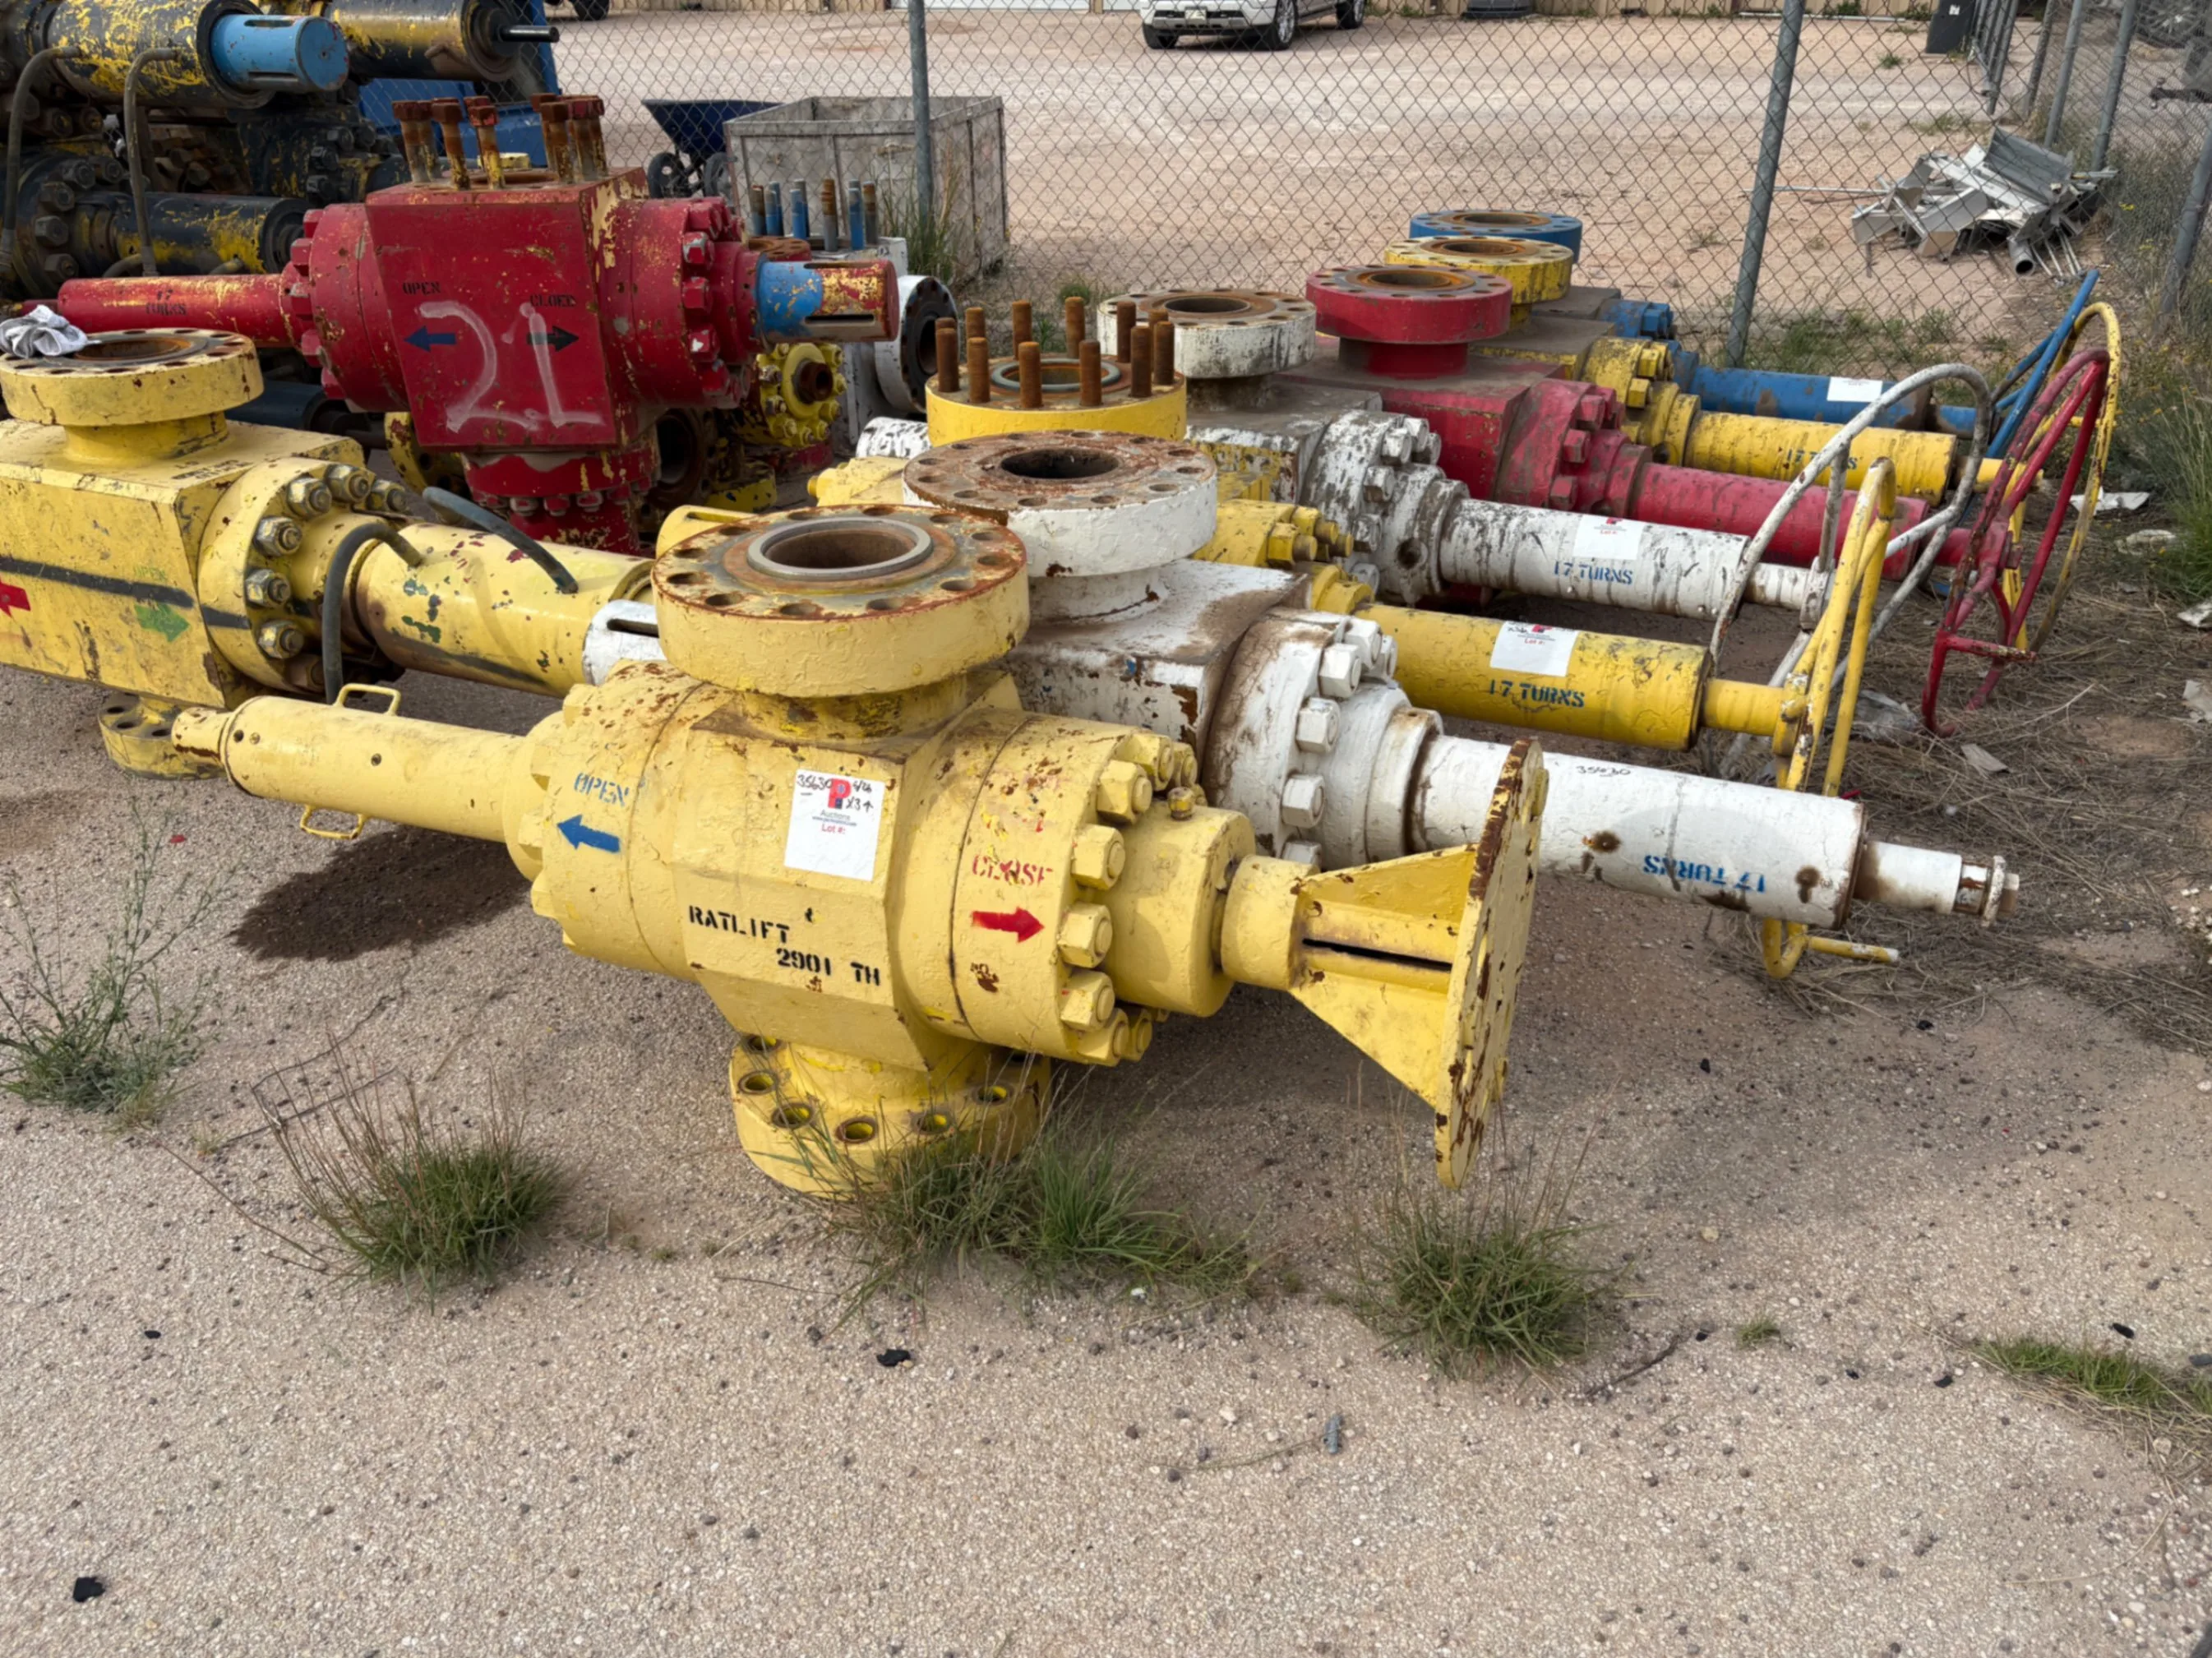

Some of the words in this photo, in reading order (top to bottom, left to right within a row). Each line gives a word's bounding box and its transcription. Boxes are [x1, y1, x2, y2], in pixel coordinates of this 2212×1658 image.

[402, 281, 442, 296] OPEN
[1554, 561, 1573, 577] 17
[1578, 564, 1633, 585] TURNS
[1489, 679, 1513, 699] 17
[1519, 682, 1586, 709] TURNS
[574, 772, 630, 808] OPEN
[820, 810, 851, 821] Auctions
[821, 823, 836, 834] Lot
[1734, 871, 1766, 894] 17
[689, 905, 790, 944] RATLIFT
[776, 947, 831, 977] 2901
[850, 961, 880, 986] TH
